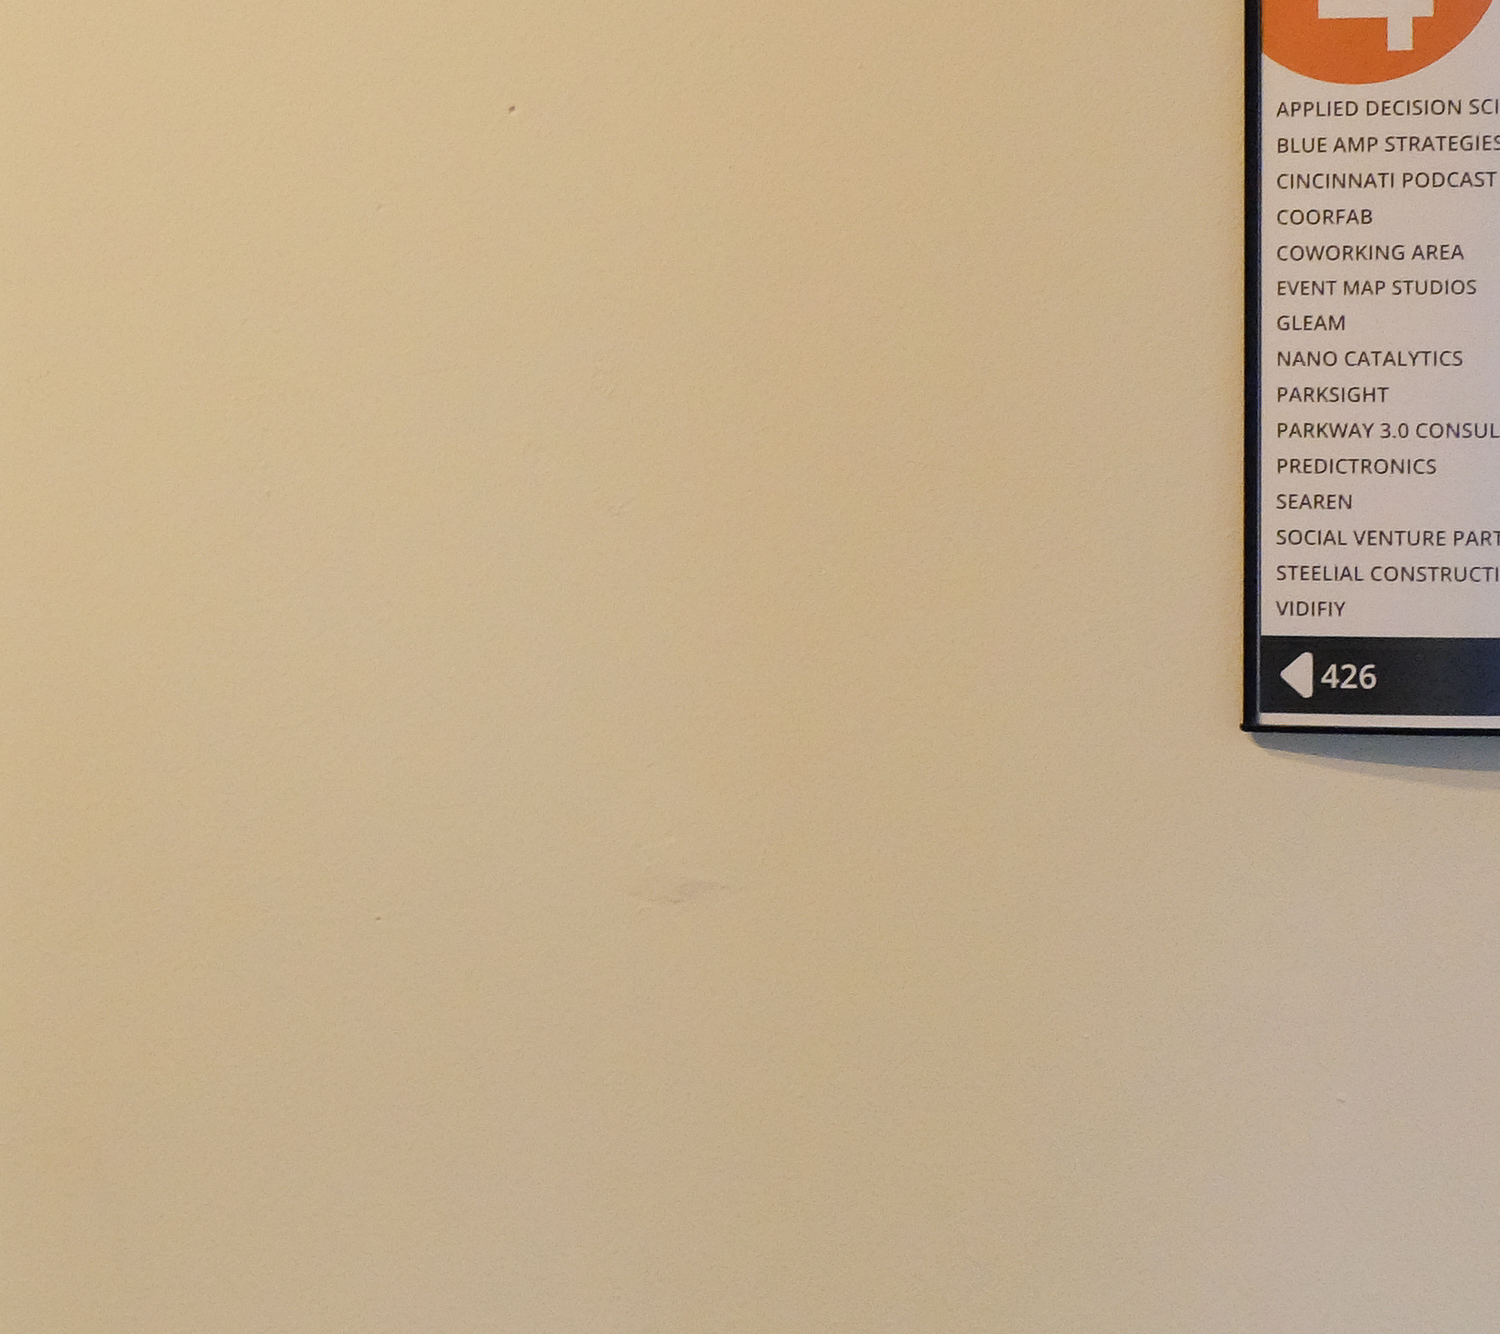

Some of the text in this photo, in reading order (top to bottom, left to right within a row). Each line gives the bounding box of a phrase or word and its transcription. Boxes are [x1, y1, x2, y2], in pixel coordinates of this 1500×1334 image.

[1275, 100, 1359, 118] APPLIED
[1365, 98, 1462, 117] DECISION
[1277, 136, 1327, 154] BLUE
[1332, 136, 1379, 153] AMP
[1276, 172, 1395, 190] CINCINNATI
[1402, 170, 1498, 189] PODCAST
[1276, 208, 1373, 226] COORFAB
[1276, 244, 1465, 262] COWORKING AREA
[1276, 279, 1477, 297] EVENT MAP STUDIOS
[1276, 314, 1346, 332] GLEAM
[1277, 350, 1464, 367] NANO CATALYTICS
[1277, 386, 1390, 403] PARKSIGHT
[1276, 422, 1375, 439] PARKWAY
[1379, 422, 1410, 439] 3.0
[1276, 458, 1437, 475] PREDICTRONICS
[1275, 493, 1353, 510] SEAREN
[1275, 529, 1348, 546] SOCIAL
[1352, 529, 1447, 547] VENTURE
[1276, 564, 1365, 582] STEELIAL
[1275, 600, 1346, 617] VIDIFIY
[1320, 663, 1377, 690] 426
